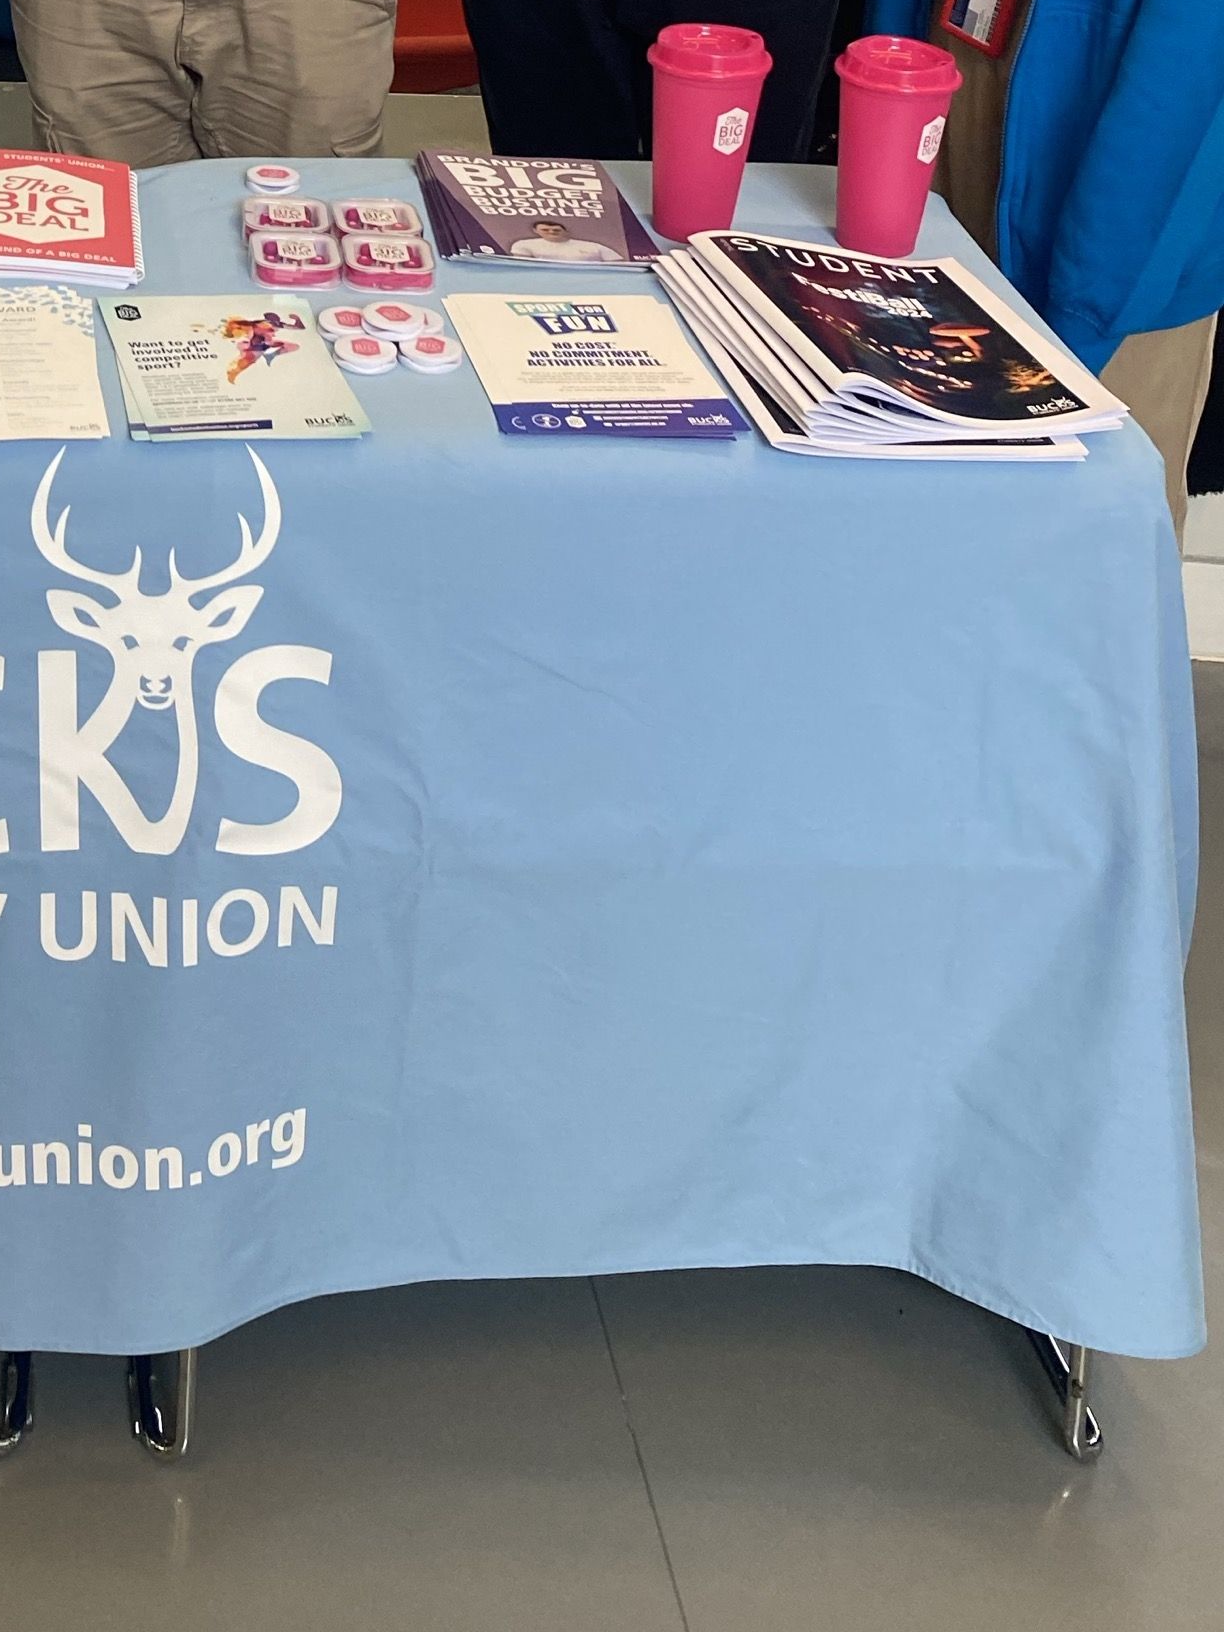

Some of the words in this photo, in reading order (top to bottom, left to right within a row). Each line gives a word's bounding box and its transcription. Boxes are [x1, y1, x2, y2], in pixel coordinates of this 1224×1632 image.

[719, 124, 743, 138] BIG
[718, 137, 741, 147] DEAL
[3, 153, 65, 164] STUDENTS'
[436, 155, 596, 171] BRANDON'S
[443, 162, 603, 192] BIG
[2, 175, 74, 194] The
[462, 185, 603, 201] BUDGET
[470, 197, 604, 211] BUSTING
[477, 207, 605, 219] BOOKLET
[45, 249, 55, 257] A
[58, 250, 81, 259] BIG
[83, 254, 117, 264] DEAL
[729, 237, 940, 284] STUDENT
[790, 271, 926, 312] FestiBall
[512, 303, 568, 314] SPORT
[579, 304, 605, 314] FOR
[886, 307, 933, 319] 2024
[542, 314, 611, 333] FUN
[127, 340, 165, 348] Want
[187, 339, 210, 348] get
[551, 341, 573, 350] NO
[131, 347, 192, 356] involved
[528, 350, 549, 359] NO
[134, 353, 218, 363] competitive
[526, 358, 605, 367] ACTIVITIES
[607, 358, 636, 367] FOR
[137, 361, 182, 372] sport?
[1025, 398, 1079, 414] BUCKS
[304, 416, 354, 426] BUCKS
[687, 414, 733, 425] BUCKS
[39, 885, 339, 968] UNION
